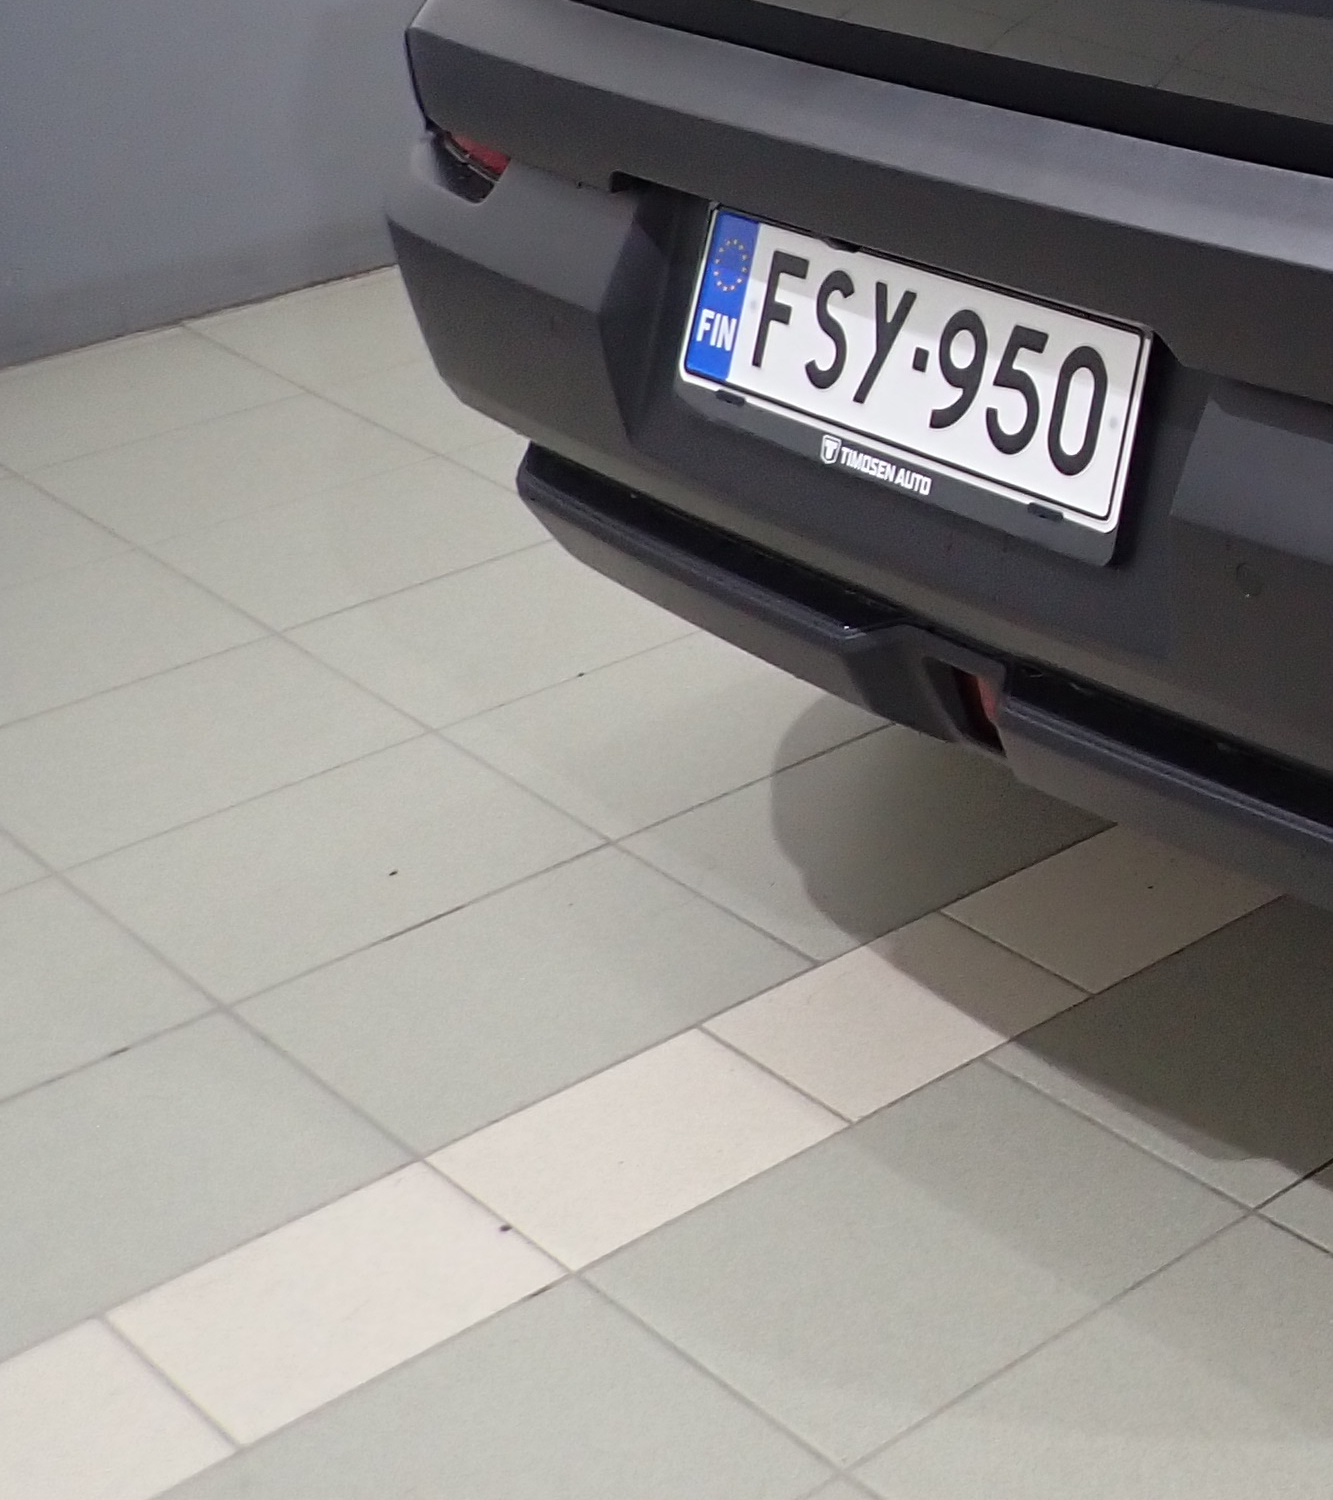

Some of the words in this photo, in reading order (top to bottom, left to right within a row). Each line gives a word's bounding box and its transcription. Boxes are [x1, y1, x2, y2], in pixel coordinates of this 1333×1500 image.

[696, 308, 736, 352] FIN
[841, 446, 897, 483] TIMOSEN
[894, 467, 932, 496] AUTO
